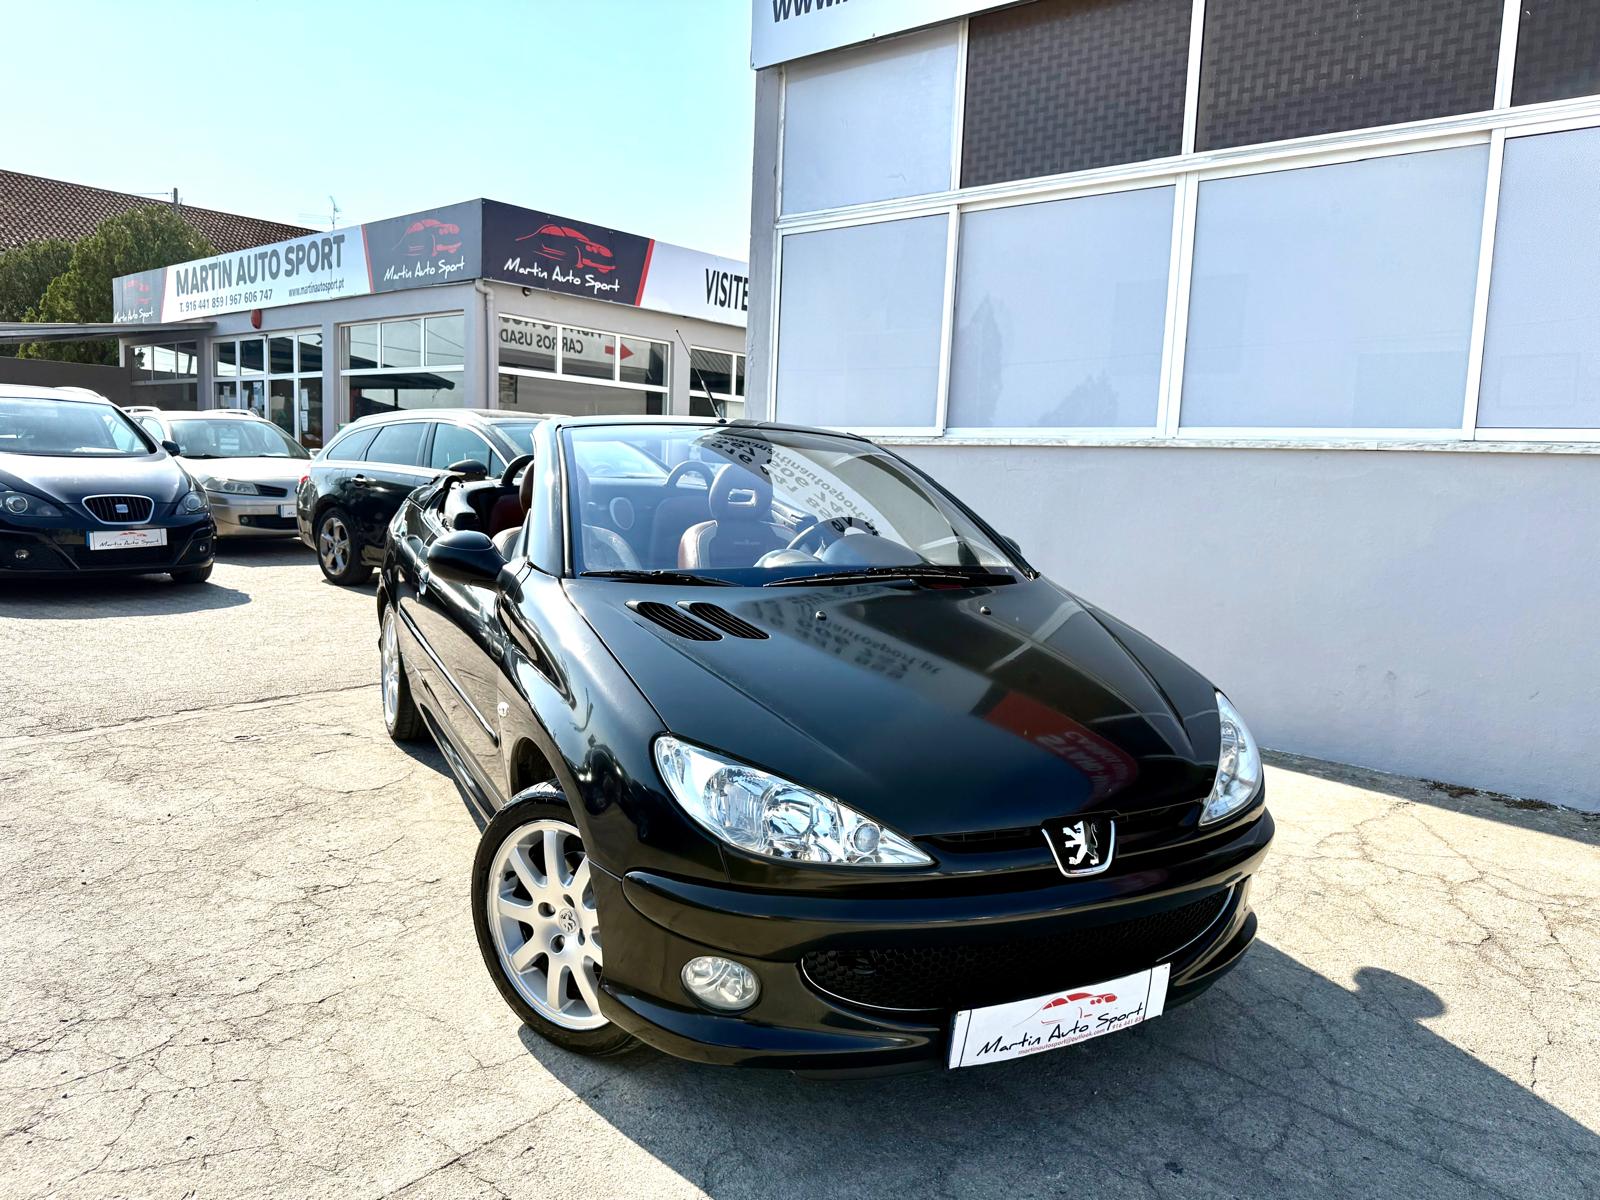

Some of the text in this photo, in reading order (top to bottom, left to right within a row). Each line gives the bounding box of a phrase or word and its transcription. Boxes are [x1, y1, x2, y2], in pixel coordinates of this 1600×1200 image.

[176, 234, 345, 297] MARTIN AUTO SPORT
[383, 255, 465, 282] Martin Auto Sport
[503, 257, 620, 294] Martin Auto Sport
[186, 301, 197, 312] 916
[199, 299, 210, 310] 441
[212, 297, 224, 308] 859
[230, 293, 242, 305] 967
[244, 292, 257, 304] 606
[260, 289, 273, 301] 747
[288, 278, 345, 297] www.martinautosport.pt
[705, 268, 748, 311] VISITE
[139, 307, 154, 322] Sport
[976, 1002, 1143, 1057] Martin Auto Sport
